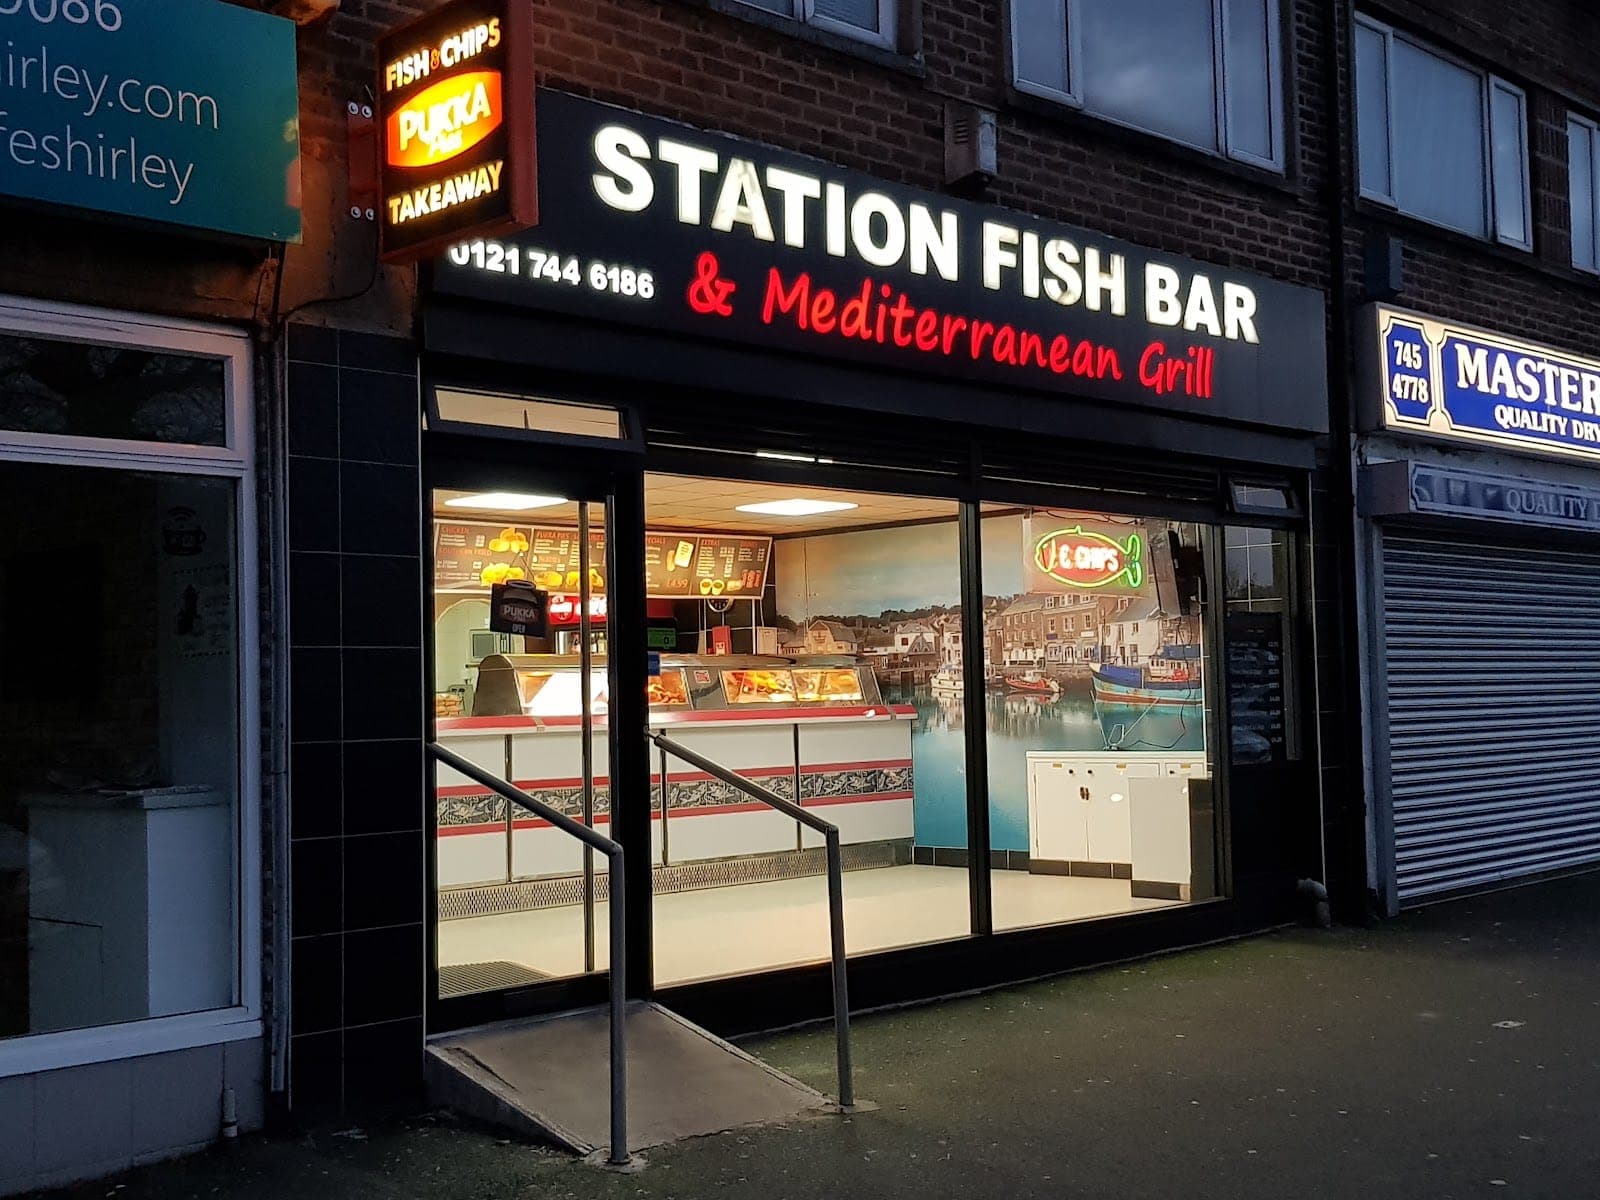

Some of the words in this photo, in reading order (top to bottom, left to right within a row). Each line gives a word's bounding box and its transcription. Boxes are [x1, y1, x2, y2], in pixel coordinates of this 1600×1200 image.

[0, 0, 122, 31] 086
[0, 40, 218, 129] irley.com
[386, 48, 430, 92] FISH
[440, 17, 501, 68] CHIPS
[400, 81, 492, 151] PUKKA
[389, 160, 504, 225] TAKEAWAY
[592, 126, 959, 281] STATION
[981, 219, 1127, 318] FISH
[1143, 258, 1261, 344] BAR
[451, 242, 520, 275] 0121
[528, 251, 582, 287] 744
[590, 262, 656, 300] 6186
[688, 251, 736, 318] &
[762, 266, 1122, 382] Mediterranean
[1138, 341, 1214, 400] Grill
[1393, 340, 1423, 370] 745
[1392, 373, 1429, 404] 4778
[1454, 343, 1600, 418] MASTER
[1494, 404, 1569, 437] QUALITY
[1505, 488, 1588, 519] QUALITY
[503, 604, 536, 619] PUKKA
